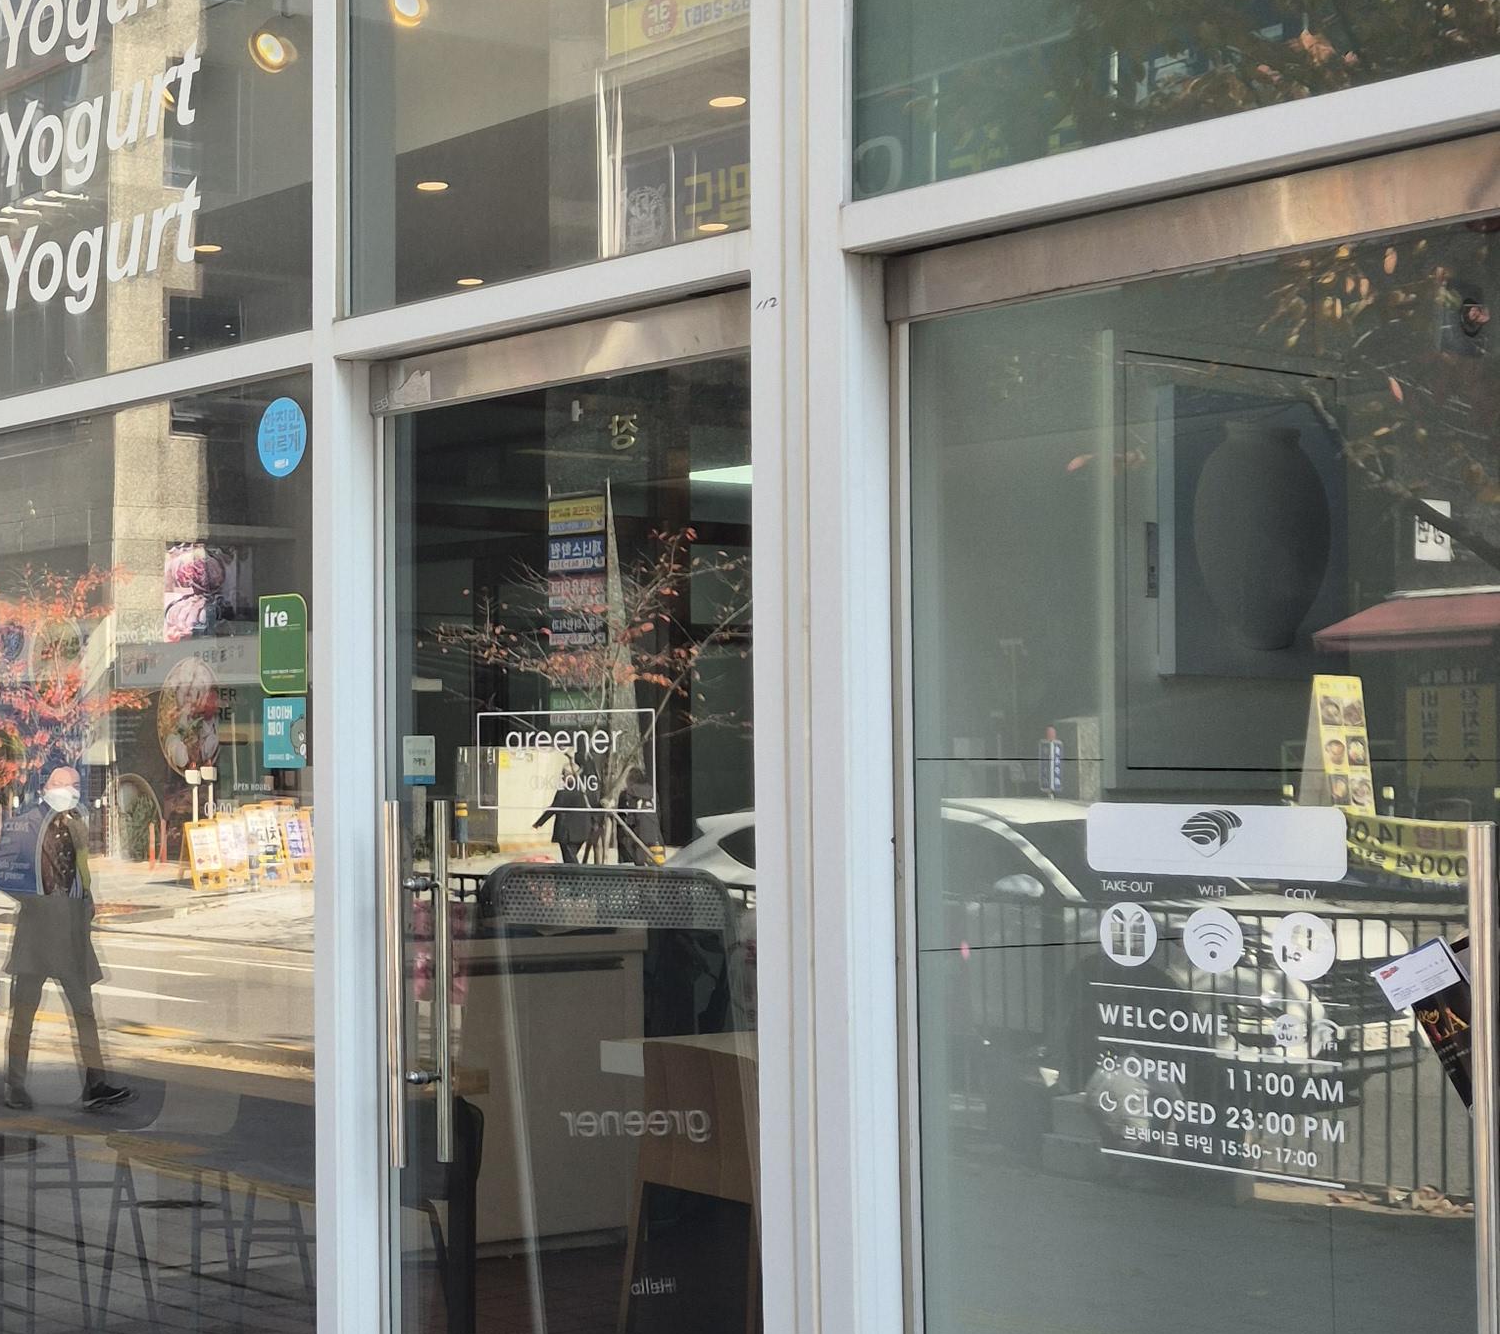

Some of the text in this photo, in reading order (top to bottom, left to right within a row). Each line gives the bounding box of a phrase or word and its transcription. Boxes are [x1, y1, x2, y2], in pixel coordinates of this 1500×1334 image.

[0, 43, 202, 188] Yogurt
[0, 176, 202, 316] Yogurt
[505, 728, 622, 755] greener
[1101, 879, 1316, 901] TAKE-OUT WI-FI CCTV
[1099, 1003, 1229, 1037] WELCOME
[1123, 1057, 1344, 1103] OPEN 11:00 AM
[1125, 1095, 1345, 1144] CLOSED 23:00 PM
[1124, 1126, 1317, 1168] 브레이크 타임 15:30~17:00
